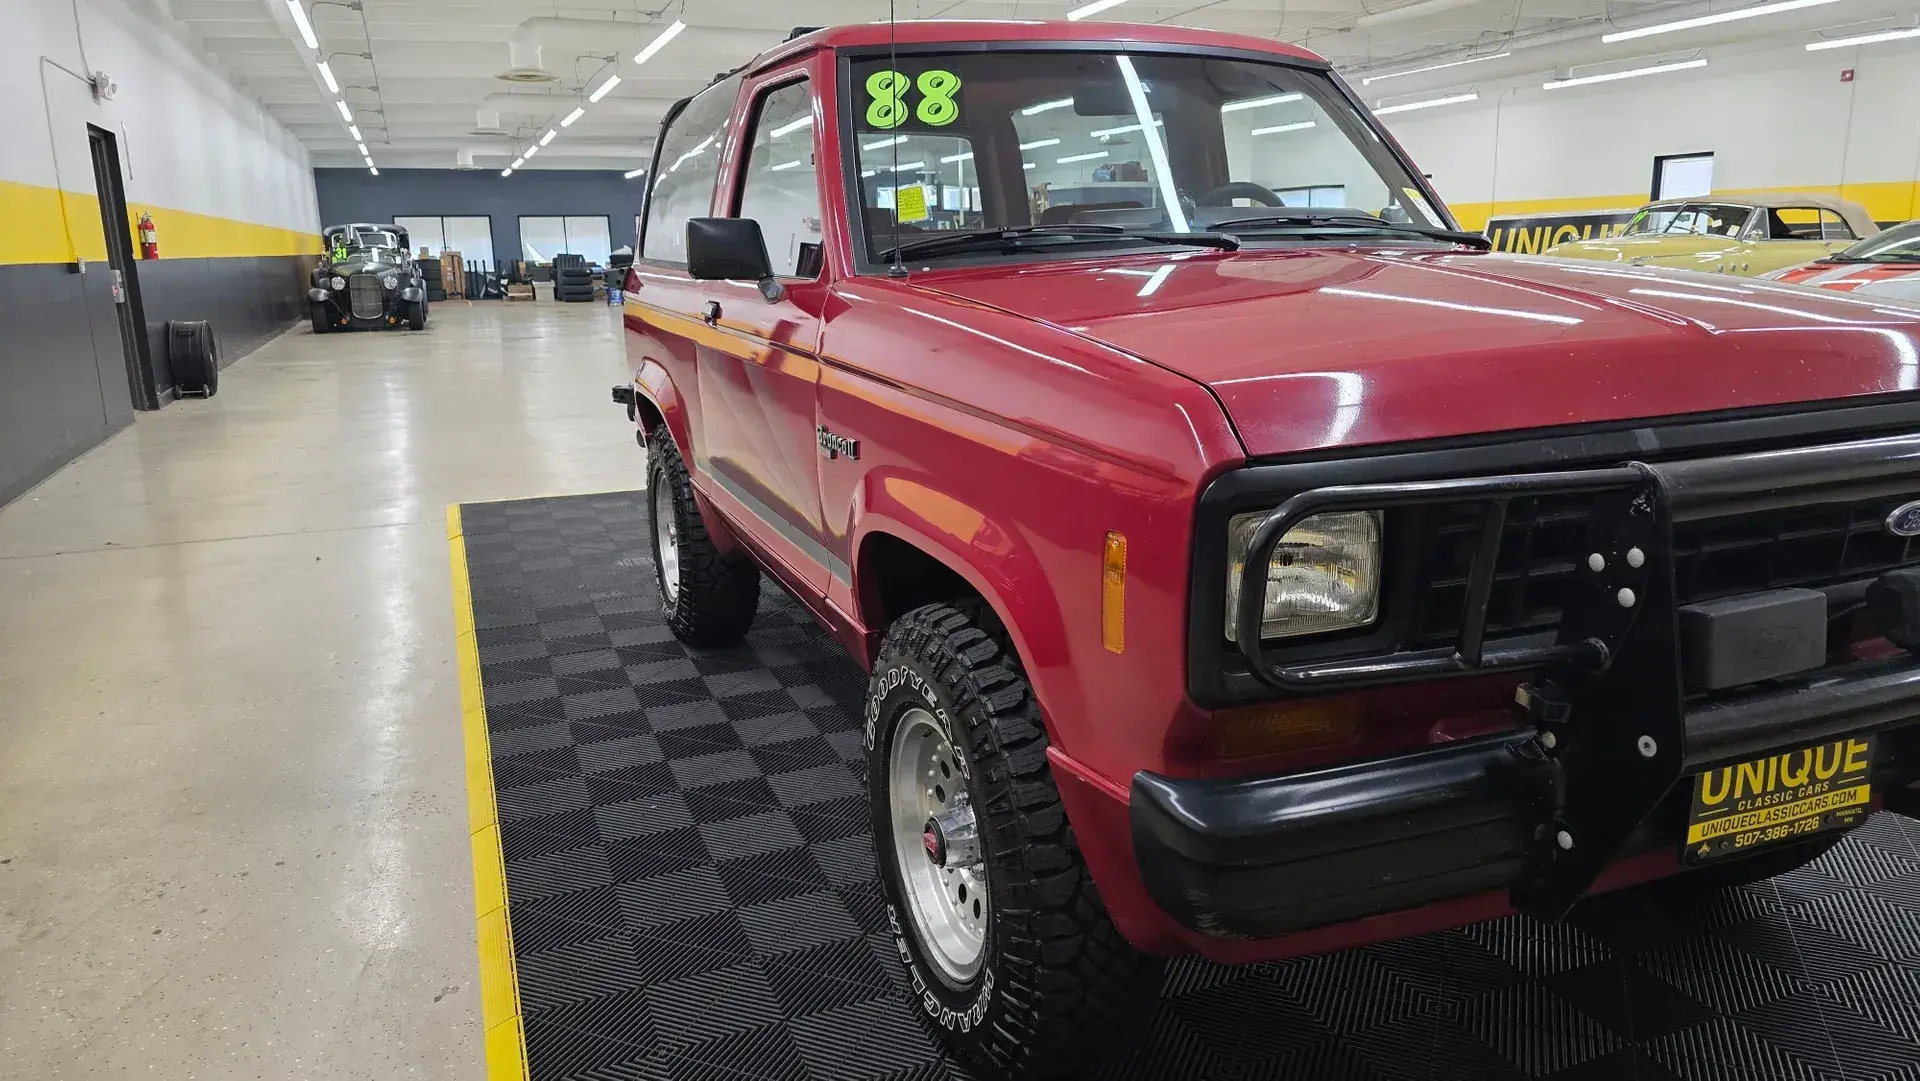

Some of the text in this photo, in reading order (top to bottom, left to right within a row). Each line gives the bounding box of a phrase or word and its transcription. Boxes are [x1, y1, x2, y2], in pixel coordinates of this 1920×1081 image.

[865, 70, 962, 129] 88
[335, 247, 347, 259] 31
[1701, 739, 1868, 806] UNIQUE
[1737, 781, 1830, 811] CLASSIC CARS
[1701, 789, 1857, 837] UNIQUECLASSICCARS.COM
[1734, 816, 1820, 848] 507-386-1726
[887, 904, 995, 1033] WRANGLER
